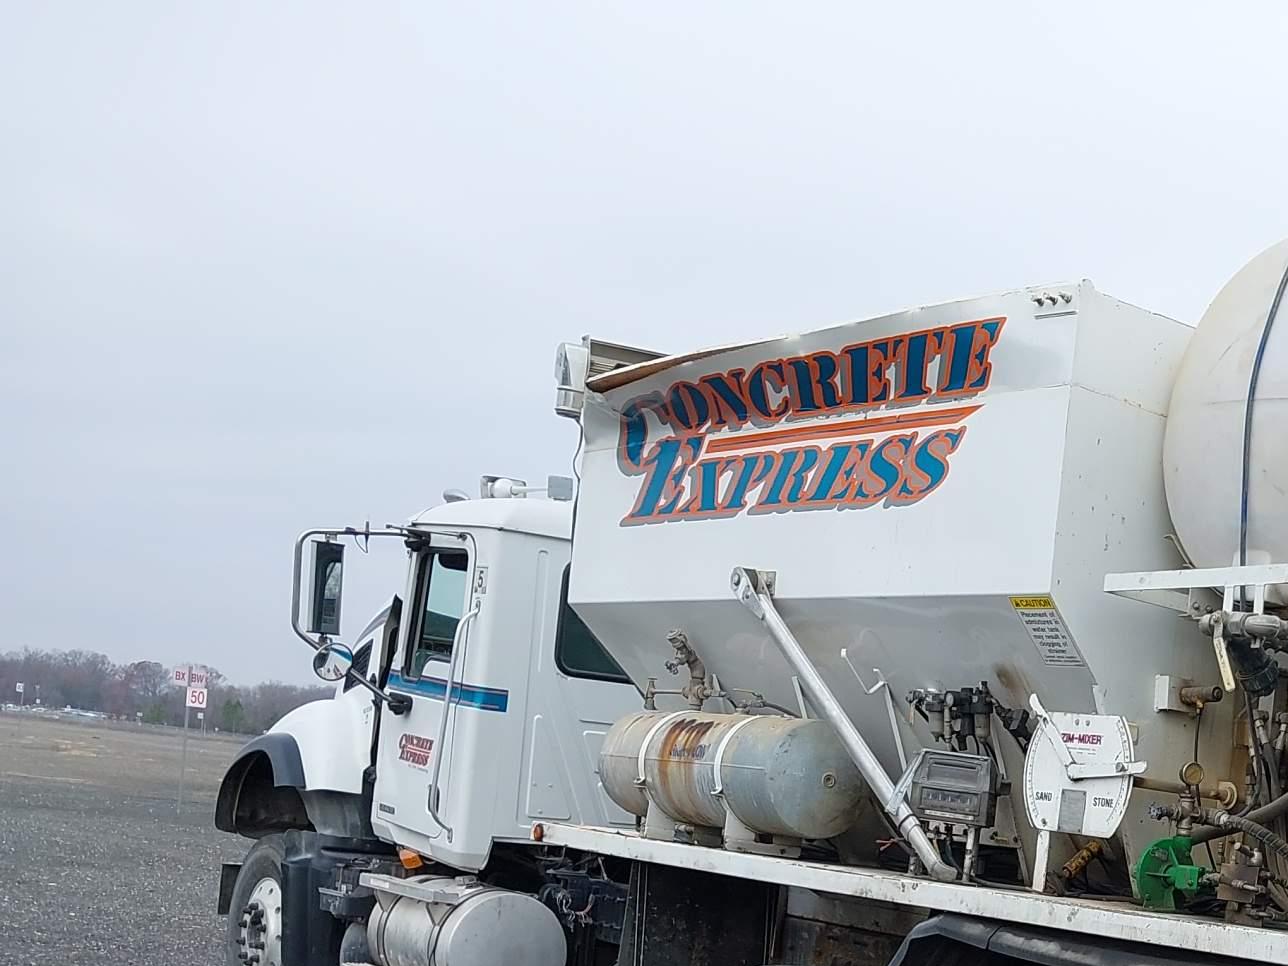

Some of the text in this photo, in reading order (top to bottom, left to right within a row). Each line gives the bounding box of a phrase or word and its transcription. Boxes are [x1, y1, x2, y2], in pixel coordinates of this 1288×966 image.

[616, 316, 1008, 477] CONCRETE
[619, 425, 968, 528] EXPRESS
[190, 690, 205, 705] 50
[1035, 791, 1053, 801] SAND
[1092, 797, 1115, 809] STONE
